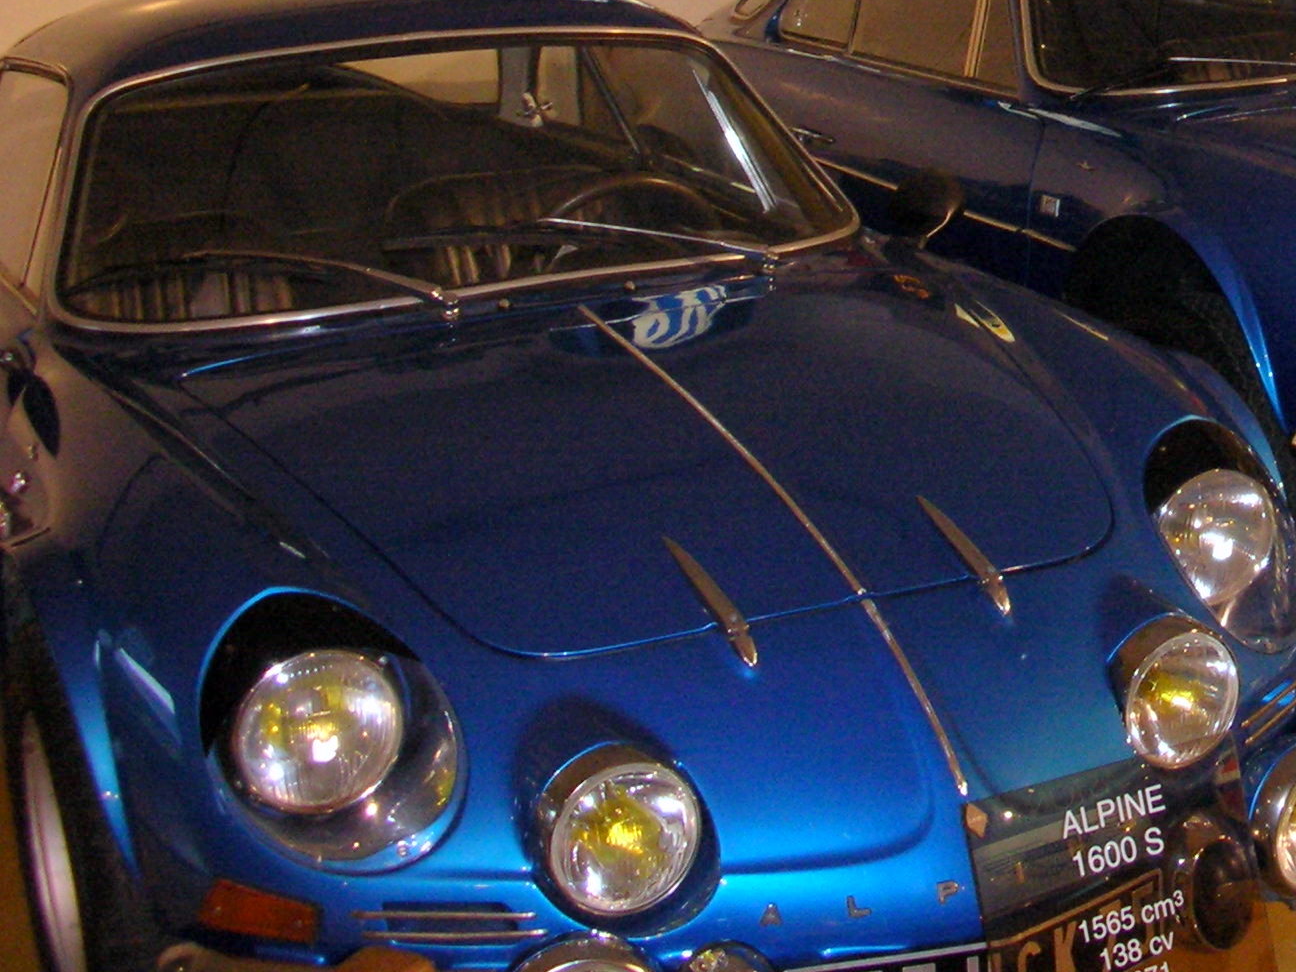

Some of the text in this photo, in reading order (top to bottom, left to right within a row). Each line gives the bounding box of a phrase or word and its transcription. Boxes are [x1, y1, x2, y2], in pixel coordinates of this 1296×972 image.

[1063, 784, 1167, 840] ALPINE
[1072, 826, 1165, 878] 1600 S
[1078, 905, 1137, 944] 1565
[1100, 938, 1143, 971] 138
[1149, 931, 1175, 956] cv
